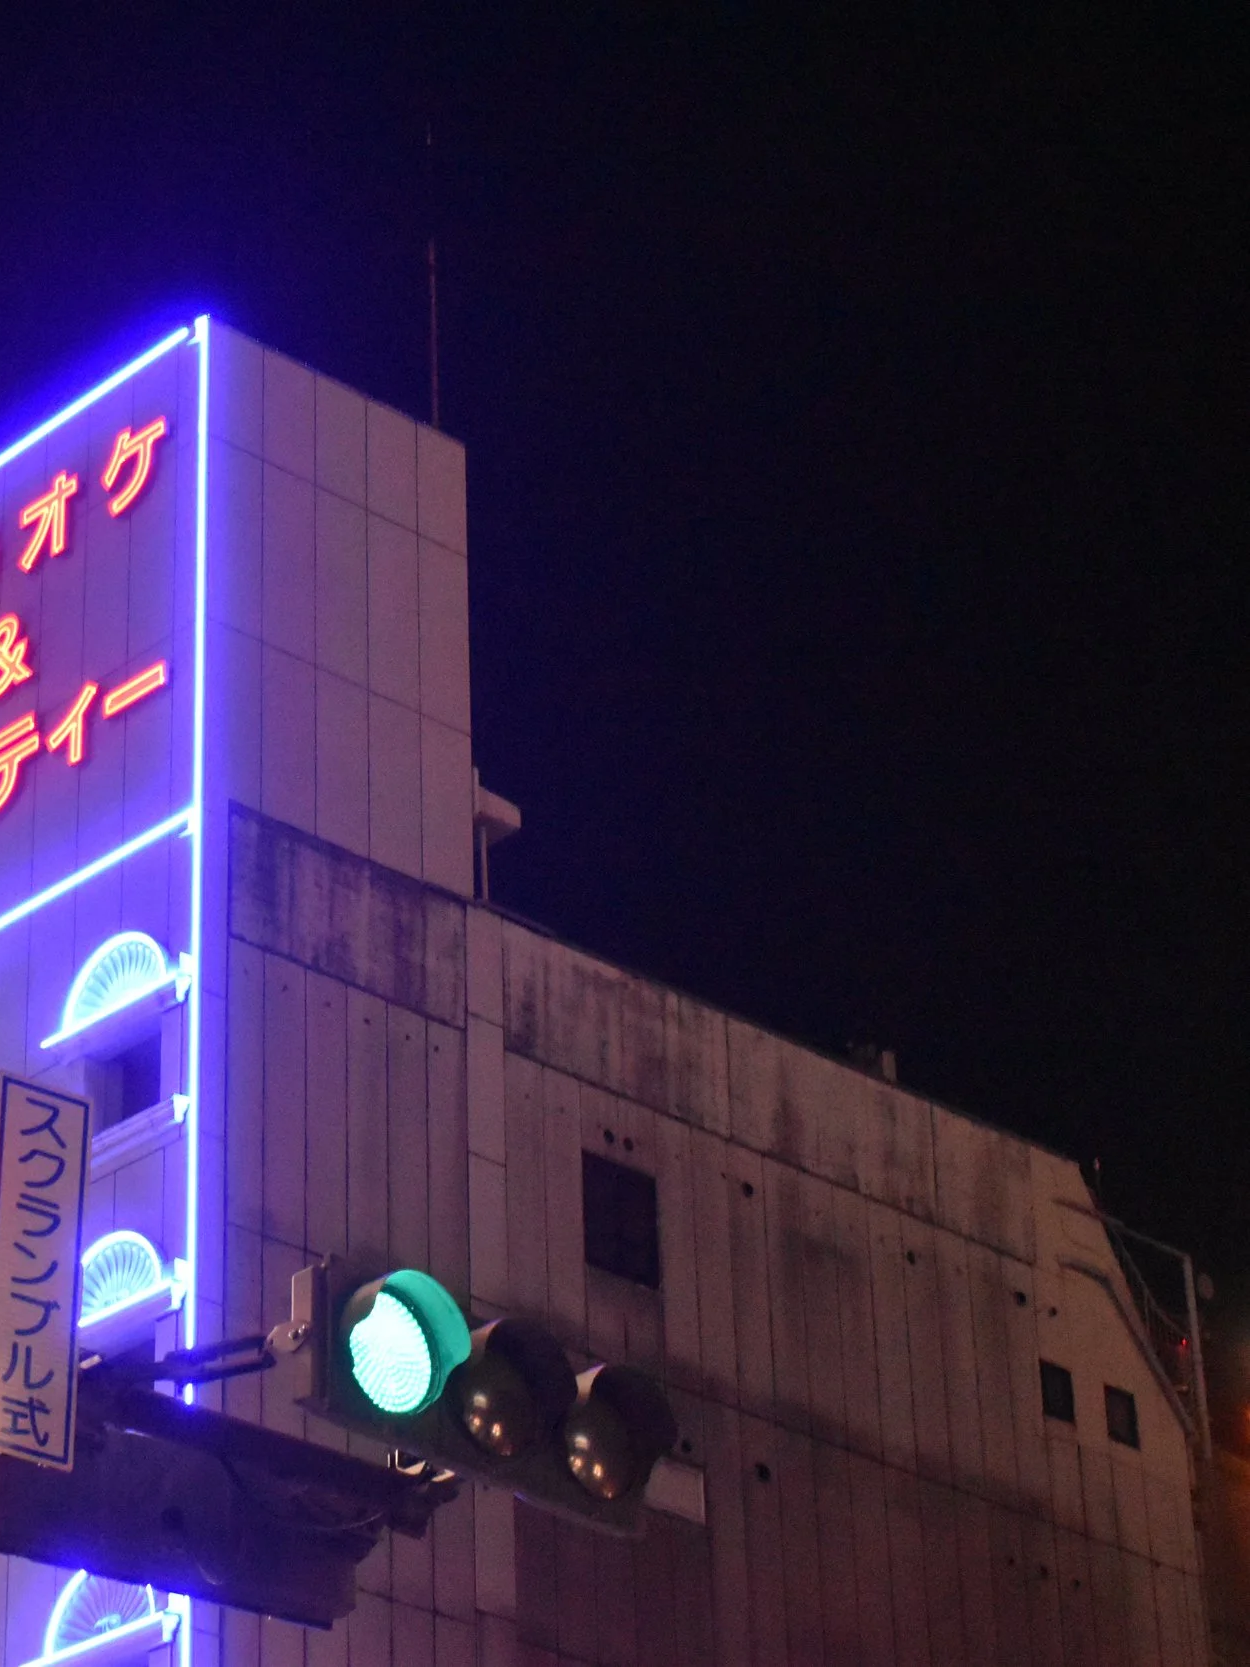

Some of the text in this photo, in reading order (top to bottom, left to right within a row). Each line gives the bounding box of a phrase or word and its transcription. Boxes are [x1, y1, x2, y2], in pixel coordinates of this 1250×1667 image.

[1, 1096, 68, 1448] スクランブル式
